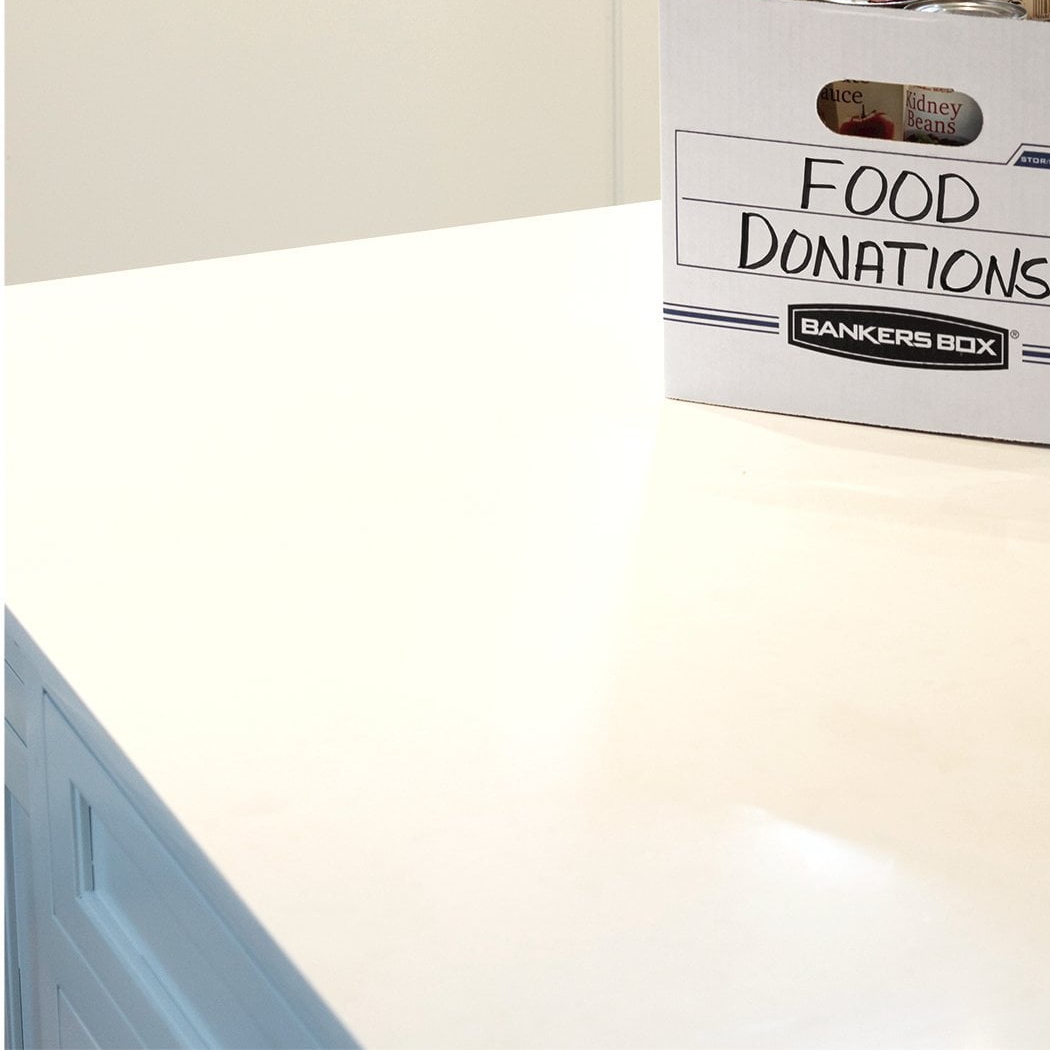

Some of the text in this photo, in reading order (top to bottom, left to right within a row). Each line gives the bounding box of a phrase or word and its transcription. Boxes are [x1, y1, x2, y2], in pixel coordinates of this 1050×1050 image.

[820, 88, 863, 104] auce
[906, 90, 963, 120] Kidney
[907, 109, 956, 135] Beans
[801, 157, 980, 223] FOOD
[738, 212, 1050, 299] DONATIONS
[801, 317, 998, 356] BANKERS BOX
